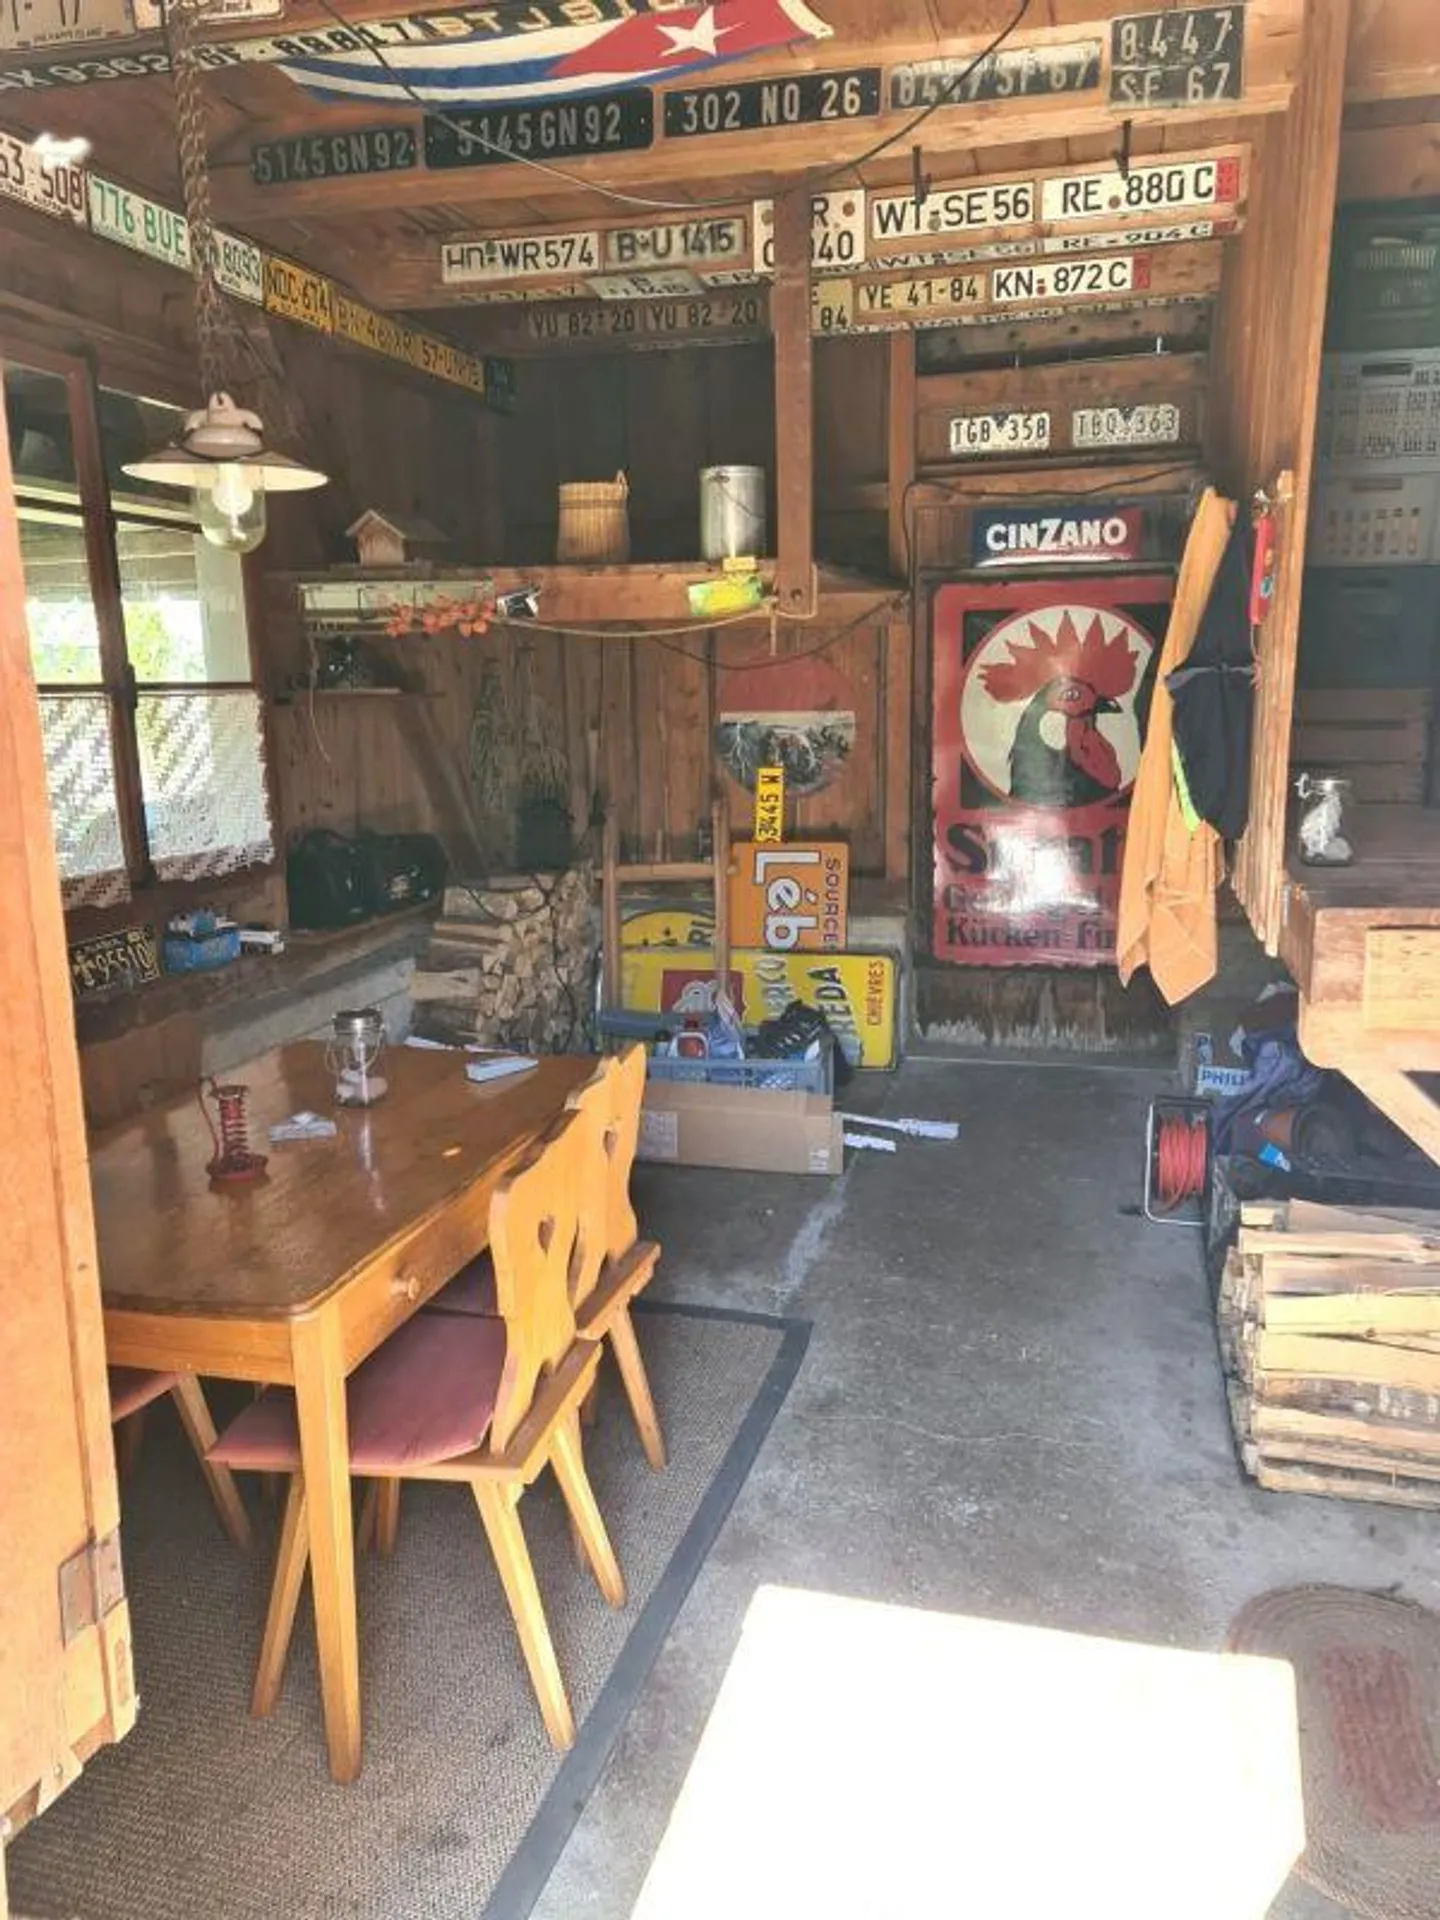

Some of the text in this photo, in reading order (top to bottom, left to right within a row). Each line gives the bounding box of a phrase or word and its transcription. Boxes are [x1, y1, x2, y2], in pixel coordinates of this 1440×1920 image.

[1120, 10, 1233, 61] 8447
[1187, 62, 1230, 101] 67
[682, 90, 741, 132] 302
[820, 77, 861, 119] 26
[986, 517, 1128, 551] CINZANO
